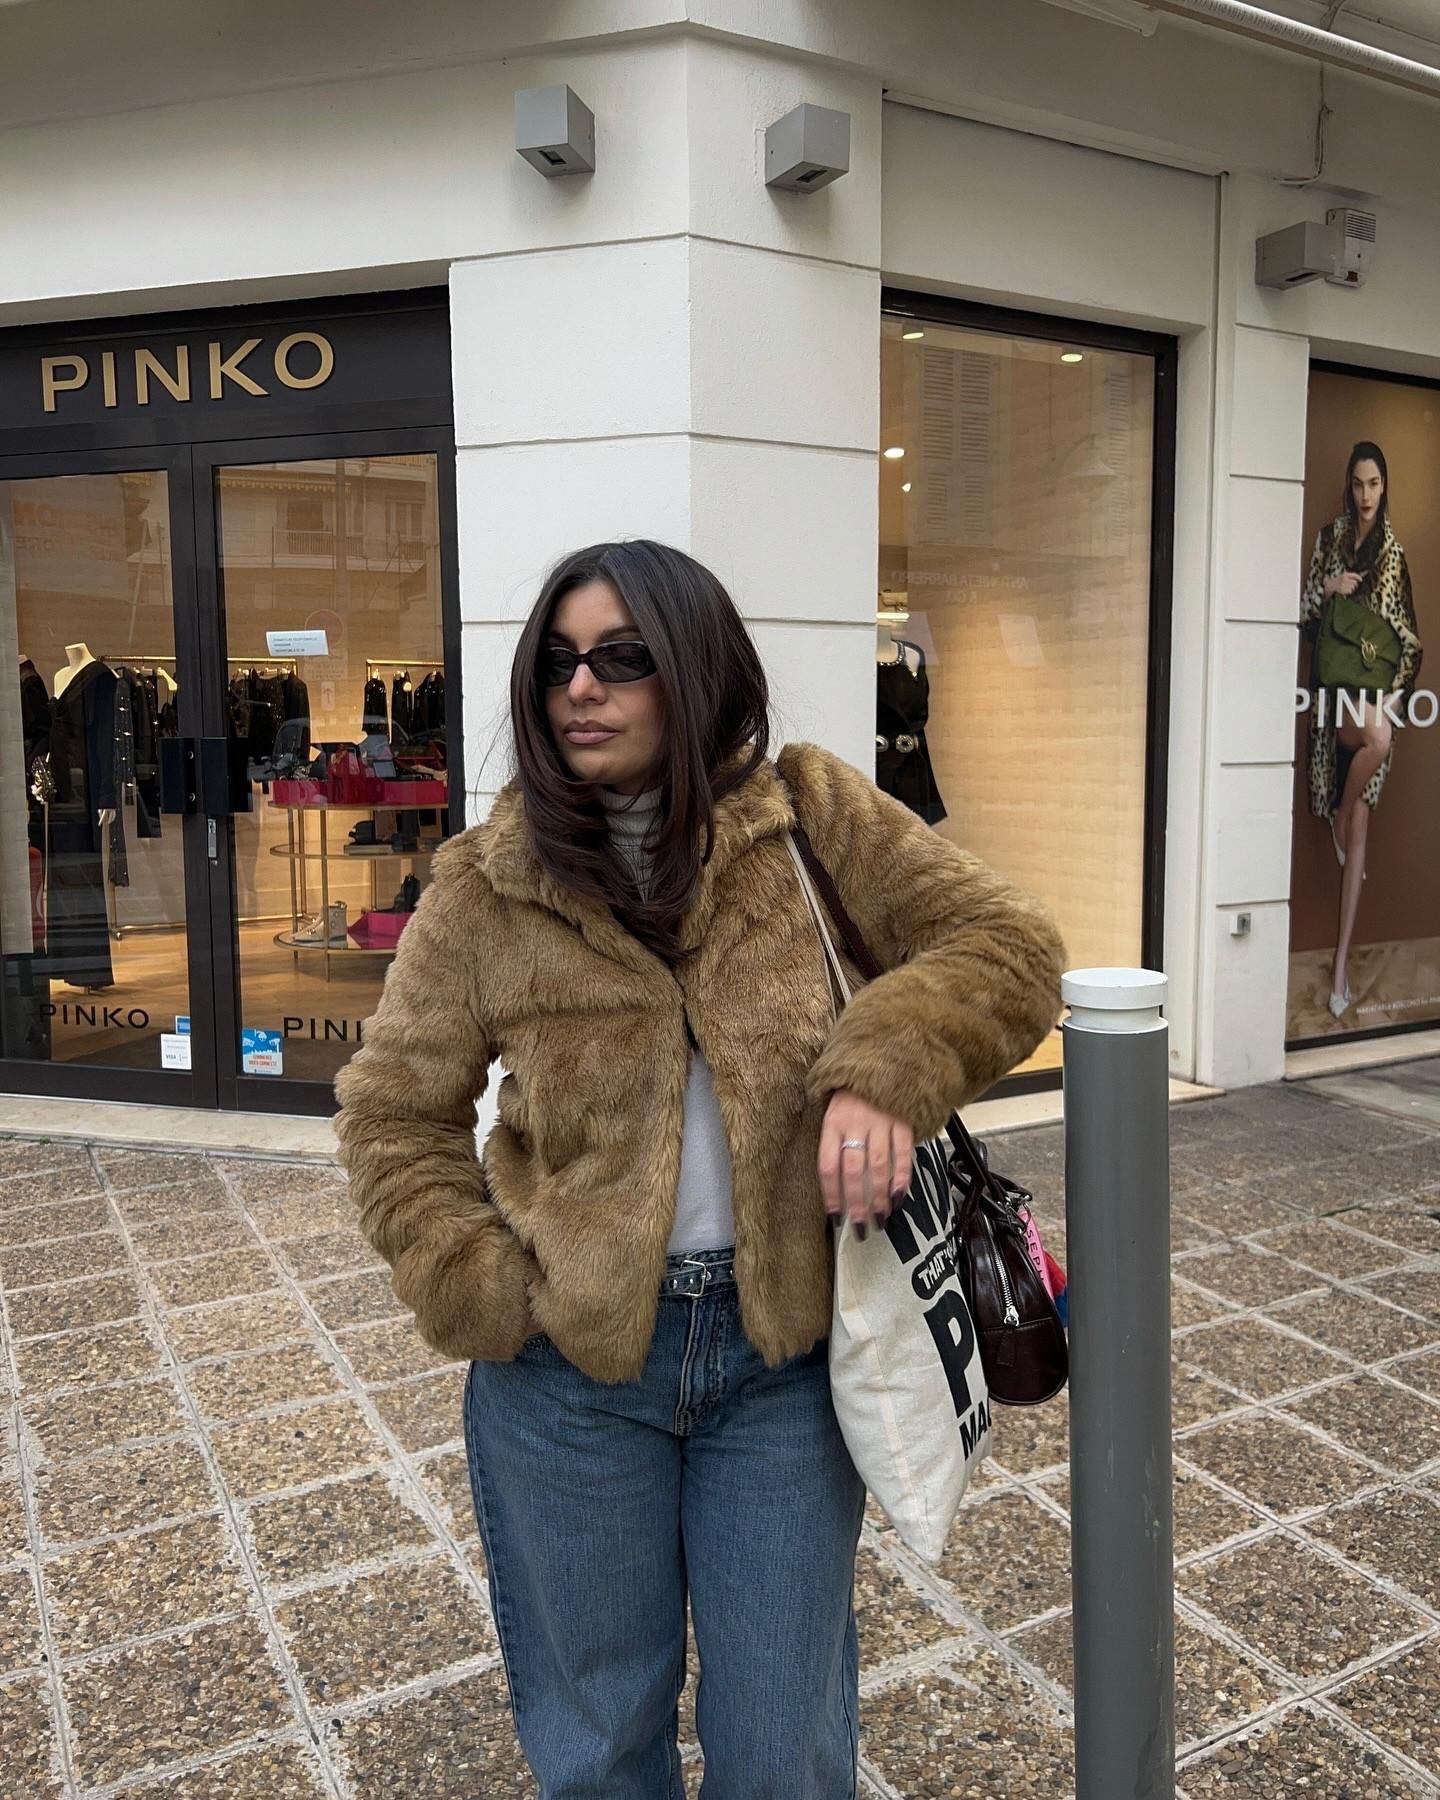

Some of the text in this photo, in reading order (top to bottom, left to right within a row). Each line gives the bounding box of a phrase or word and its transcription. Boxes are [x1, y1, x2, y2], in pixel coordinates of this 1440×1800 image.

[41, 332, 335, 413] PINKO
[1295, 687, 1439, 729] PINKO
[39, 1004, 149, 1029] PINKO
